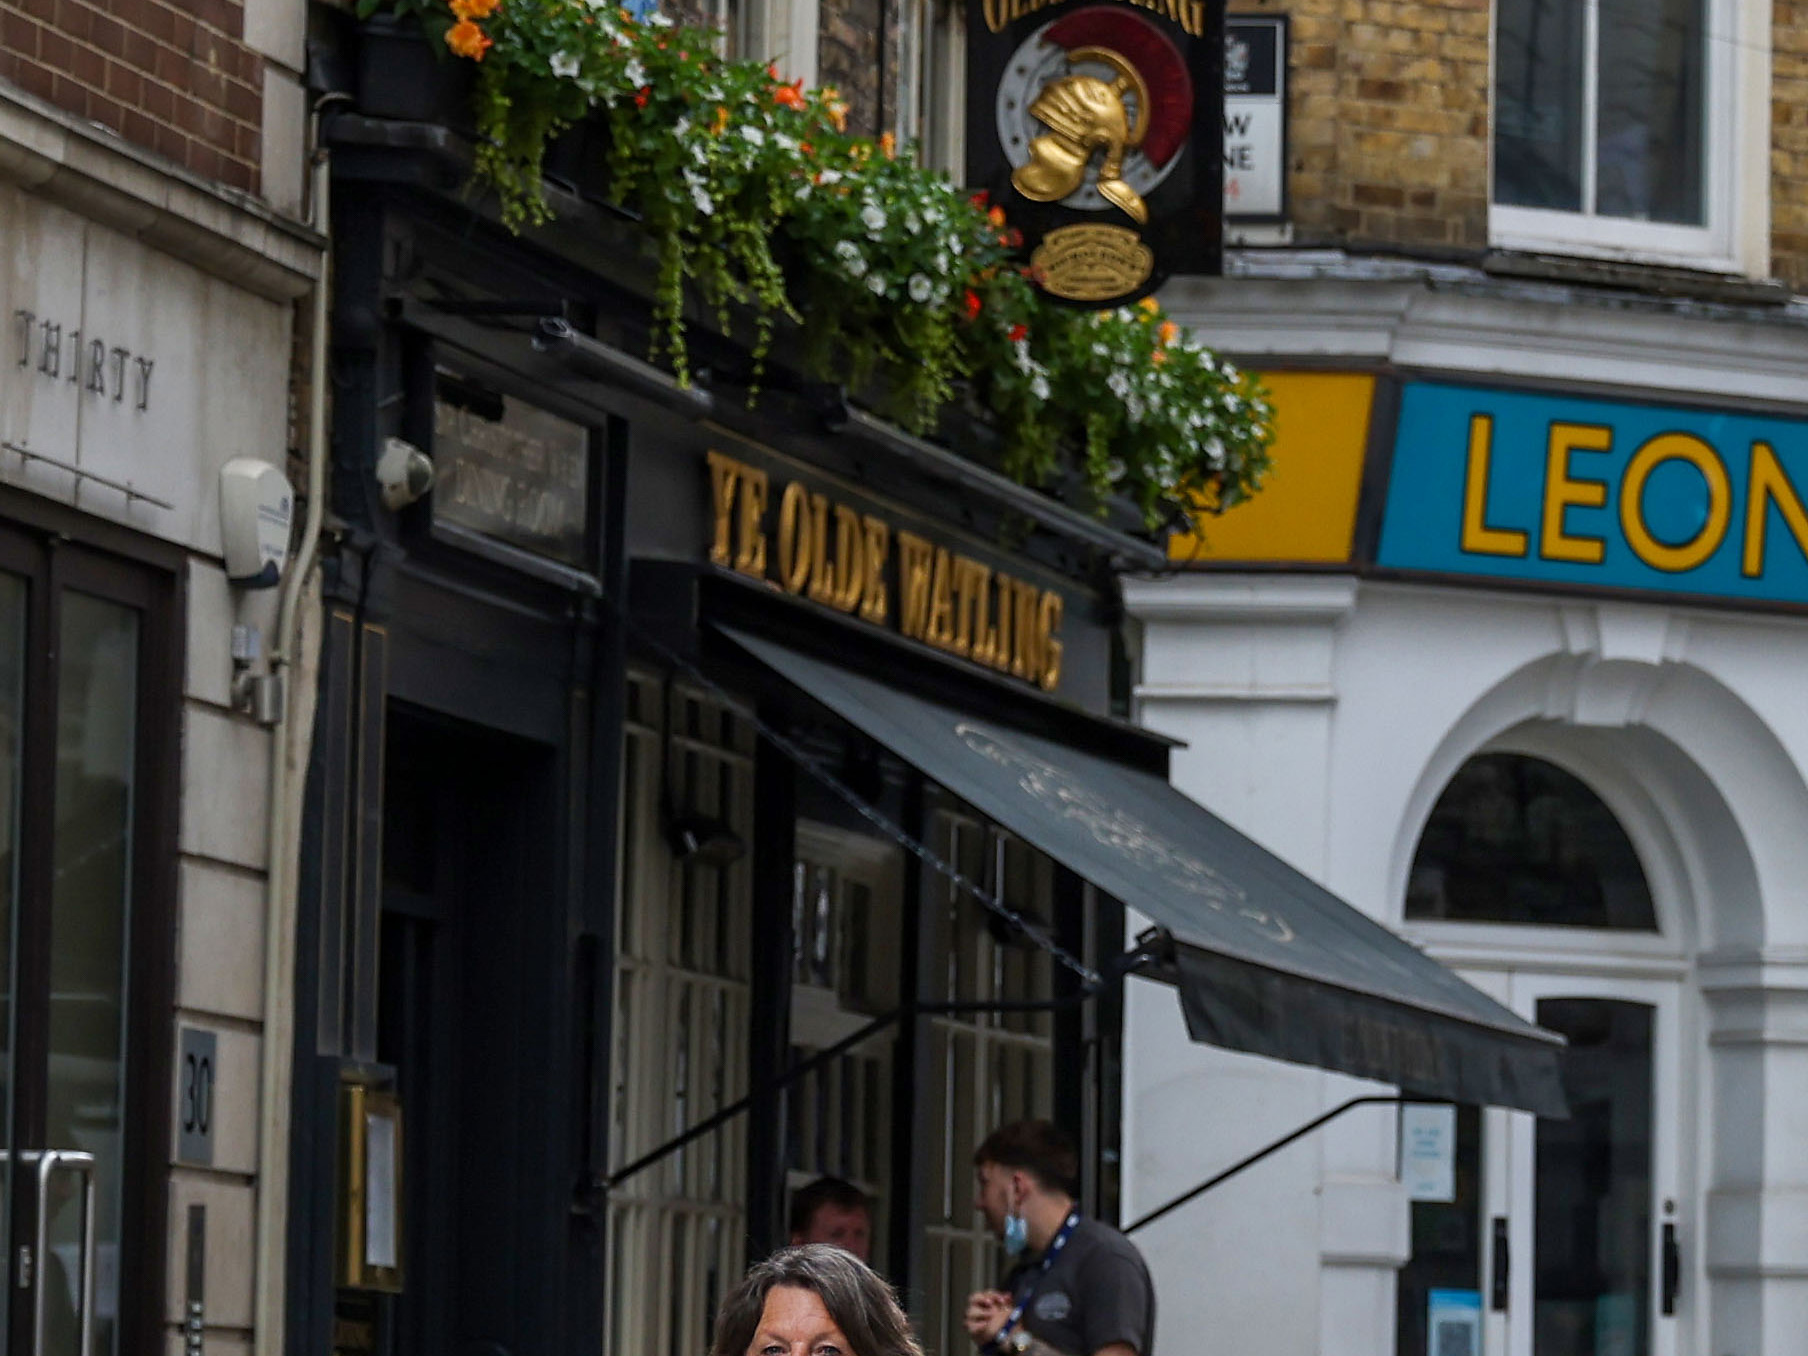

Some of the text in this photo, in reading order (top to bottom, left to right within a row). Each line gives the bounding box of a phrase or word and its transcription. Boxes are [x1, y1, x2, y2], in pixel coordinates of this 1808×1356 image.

[13, 309, 155, 412] THIRTY
[706, 448, 769, 578] YE
[777, 480, 889, 625] OLDE
[896, 529, 1064, 693] WATLING
[184, 1052, 213, 1136] 30
